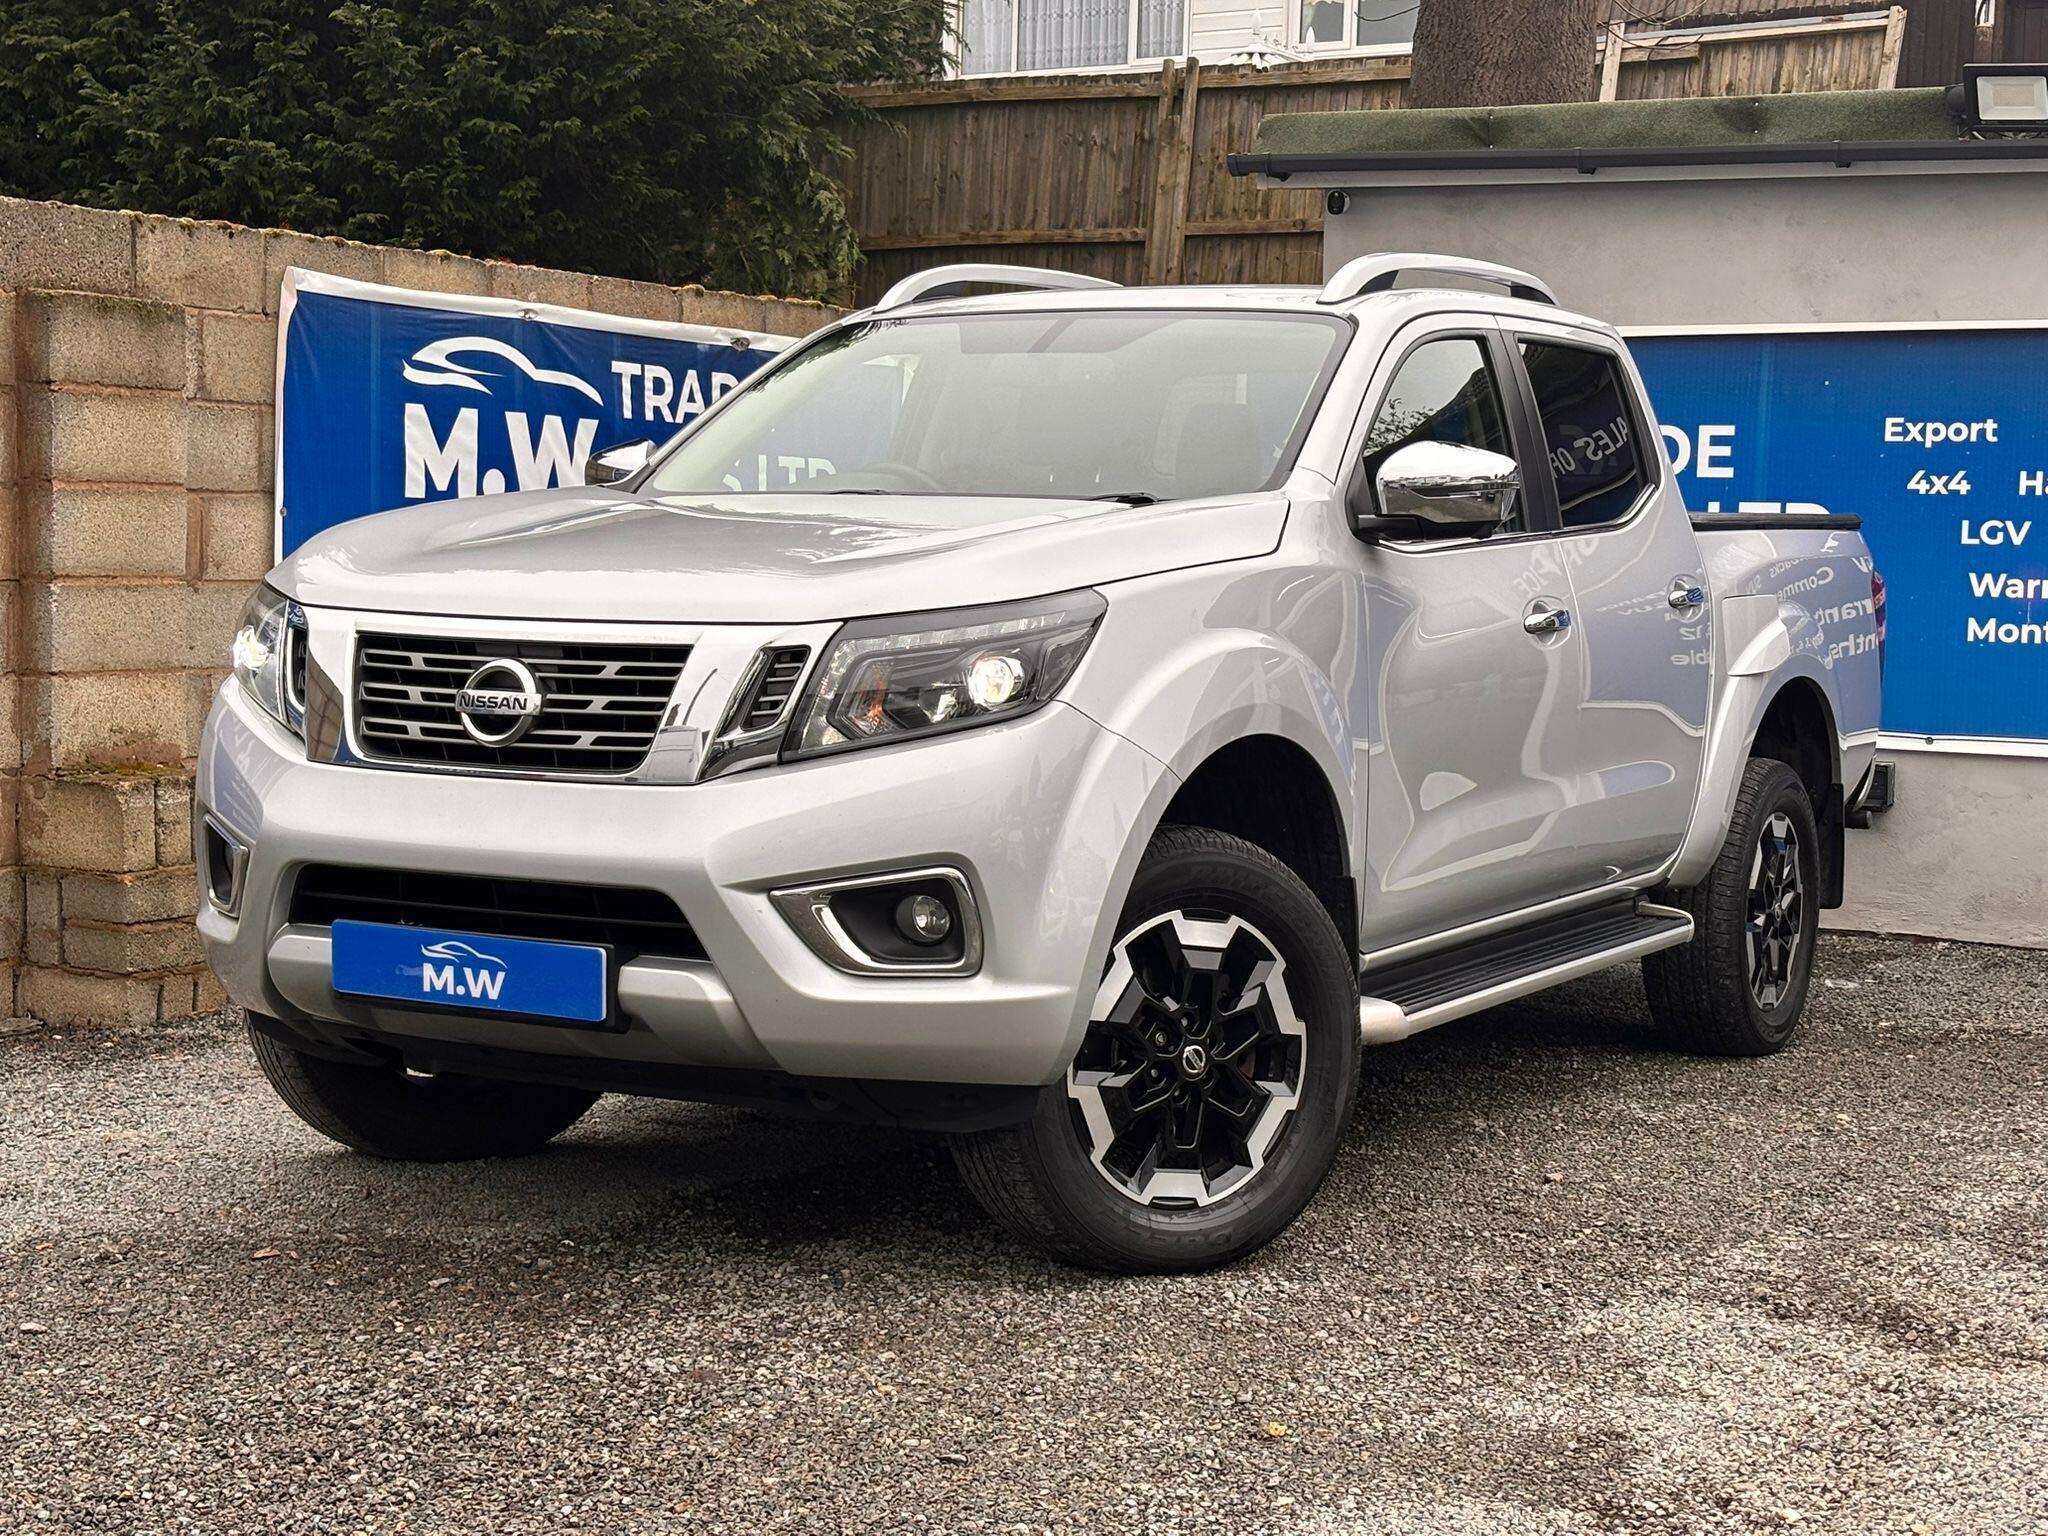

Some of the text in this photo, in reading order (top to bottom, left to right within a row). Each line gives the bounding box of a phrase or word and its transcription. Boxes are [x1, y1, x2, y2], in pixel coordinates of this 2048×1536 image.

[1884, 417, 1999, 448] Export
[404, 402, 599, 498] M.W
[1907, 469, 1971, 495] 4x4
[1961, 519, 2032, 545] LGV
[459, 693, 528, 711] NISSAN
[422, 962, 507, 1001] M.W
